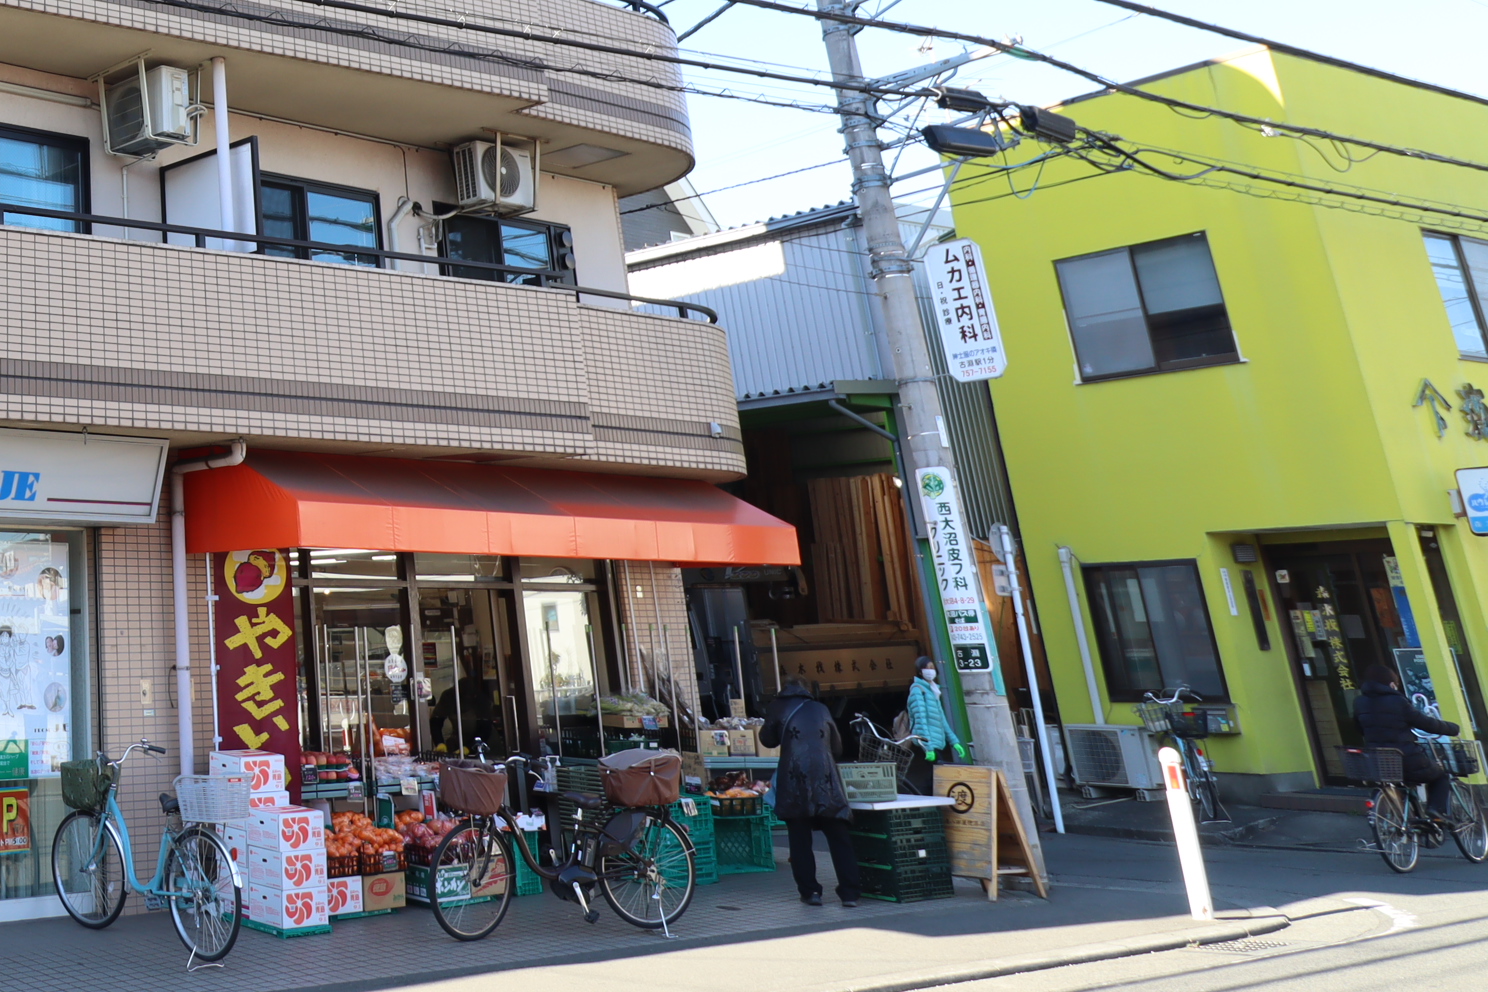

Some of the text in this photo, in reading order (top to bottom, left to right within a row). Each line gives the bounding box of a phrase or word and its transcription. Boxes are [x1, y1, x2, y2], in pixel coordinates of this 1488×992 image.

[944, 248, 978, 344] ムカエ内科
[959, 357, 995, 369] 古淵駅1分
[961, 365, 997, 377] 757-7155
[930, 526, 949, 592] クリニック
[935, 501, 968, 591] 西大沼皮フ科
[958, 659, 982, 668] 3-23
[224, 606, 293, 790] やきい
[2, 796, 18, 834] P
